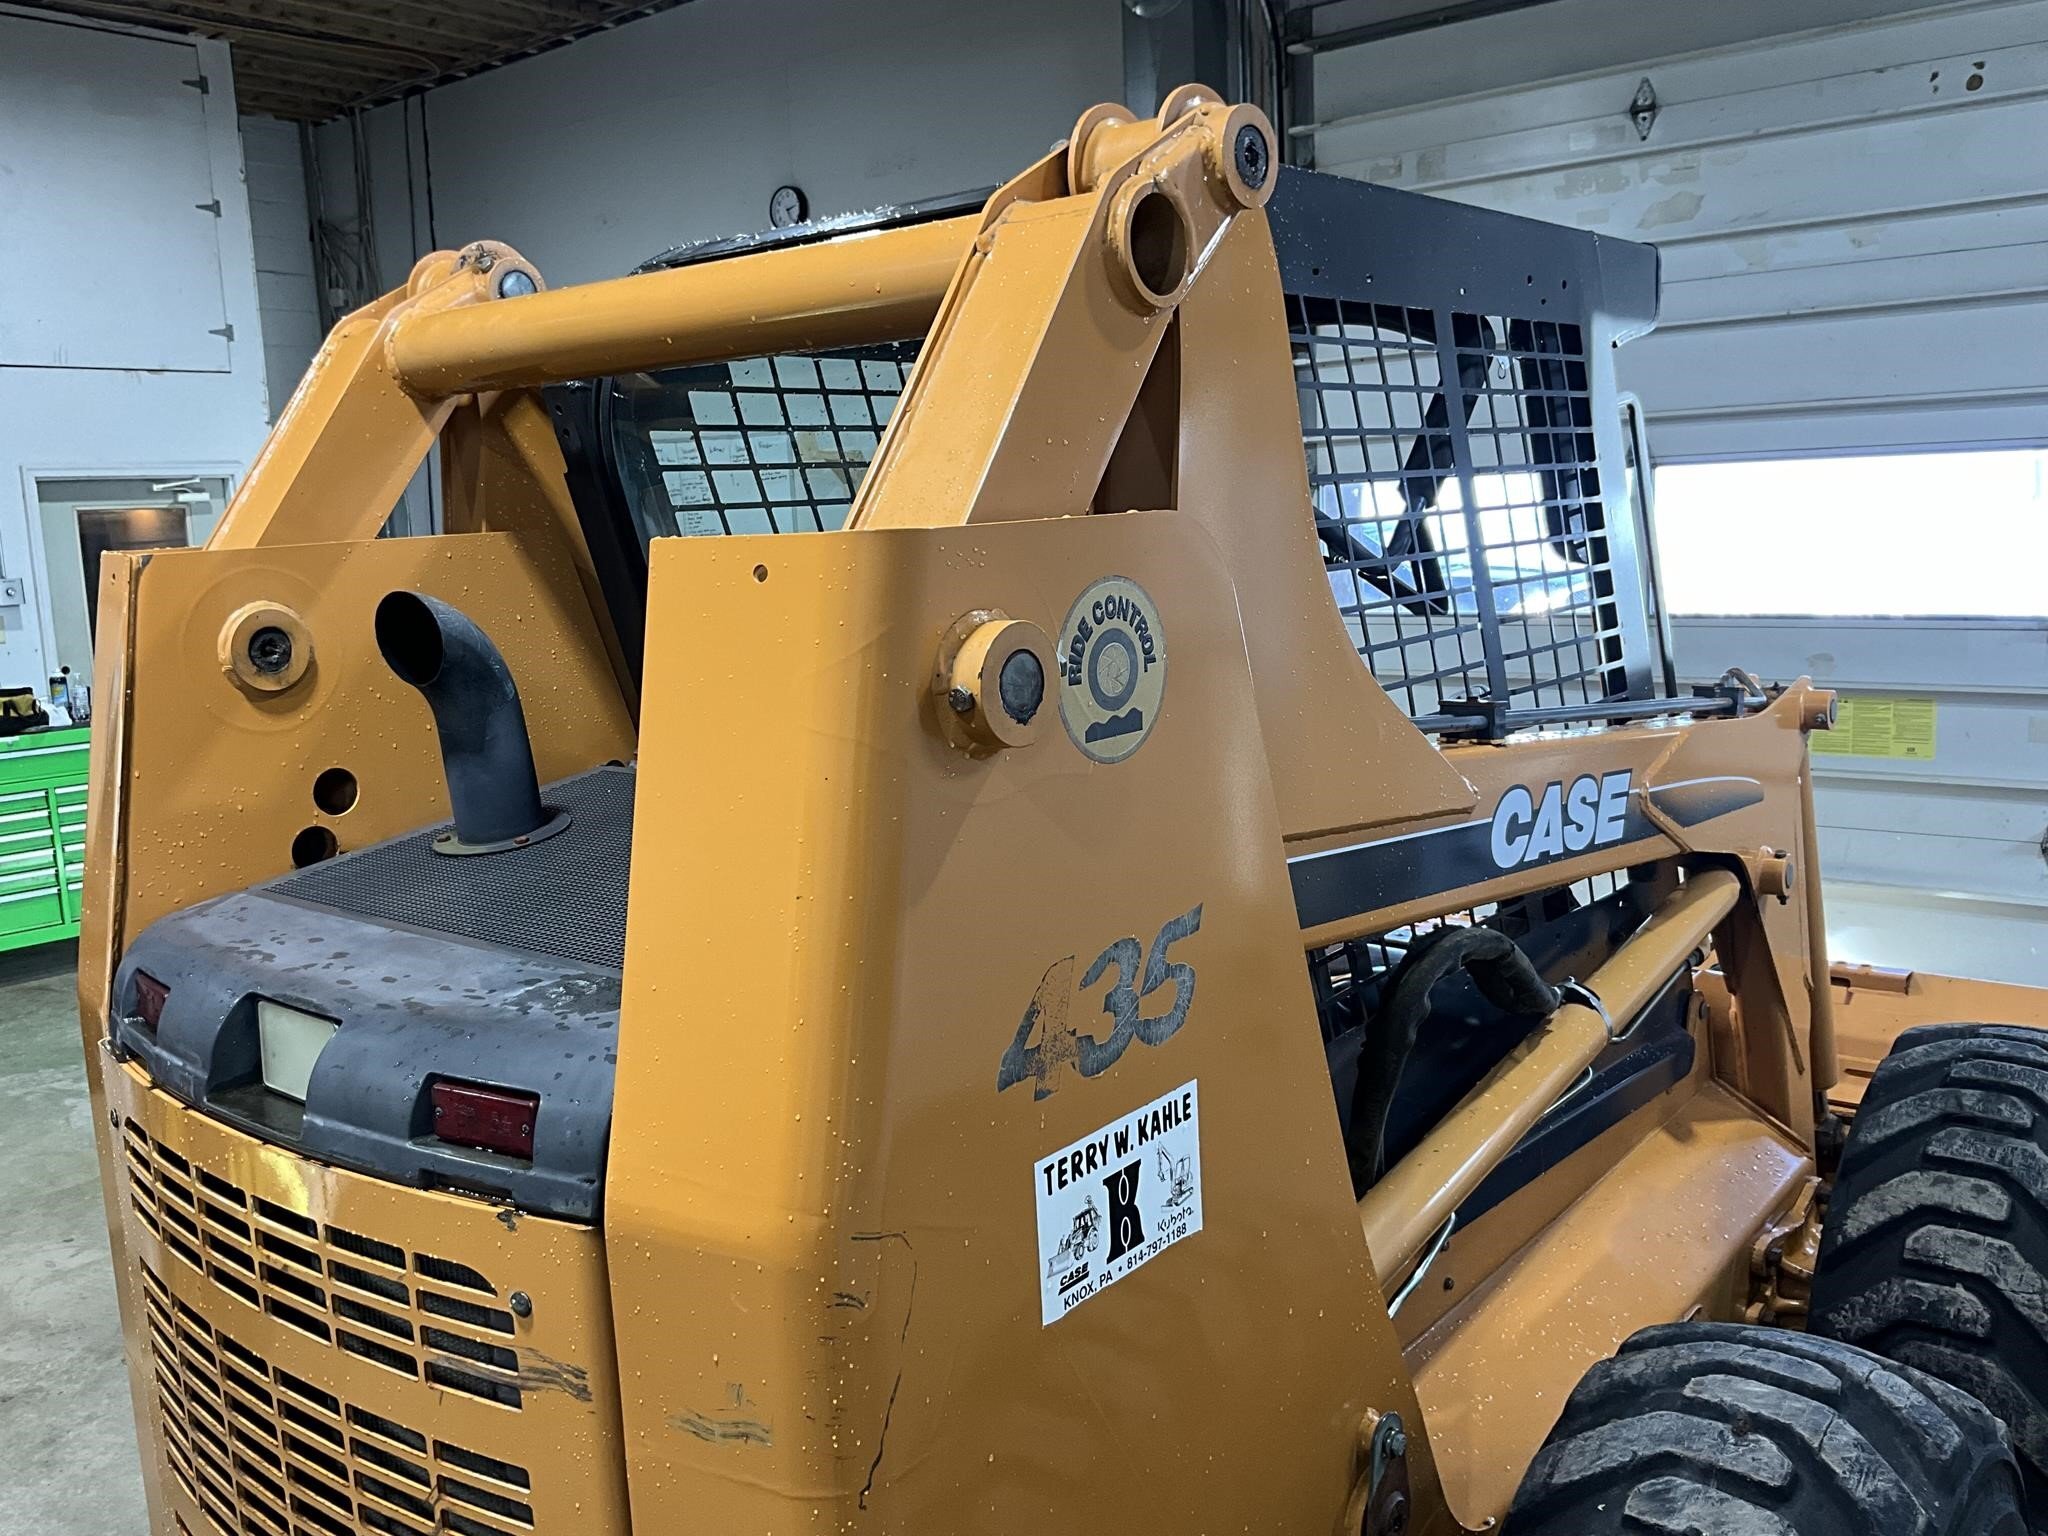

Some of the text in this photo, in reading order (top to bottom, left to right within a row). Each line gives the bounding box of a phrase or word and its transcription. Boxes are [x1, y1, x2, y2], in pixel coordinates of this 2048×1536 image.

[1068, 595, 1157, 686] RIDE CONTROL
[1491, 769, 1632, 868] CASE
[997, 902, 1203, 1101] 435
[1043, 1092, 1192, 1196] TERRY W. KAHLE
[1157, 1207, 1193, 1232] Kubota
[1060, 1261, 1089, 1287] CASE
[1063, 1222, 1187, 1310] KNOX, PA 814-797-1188
